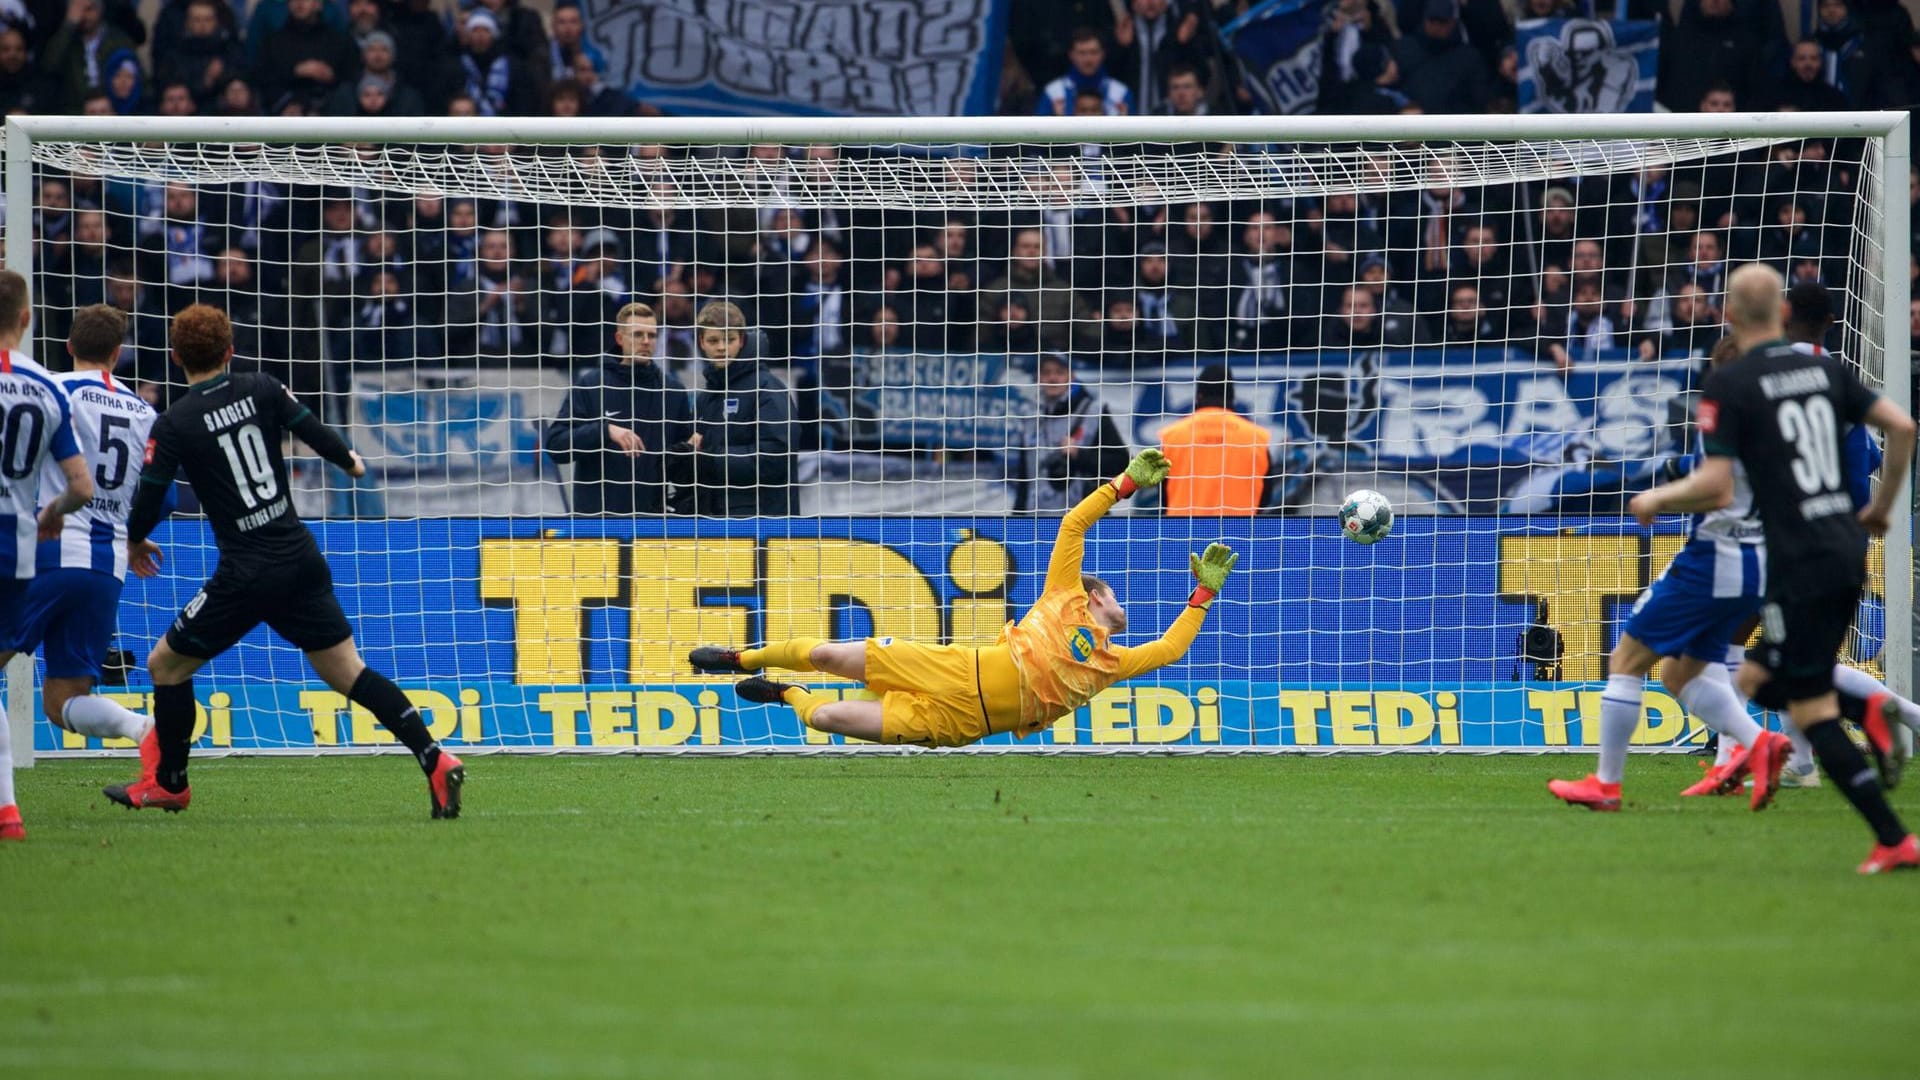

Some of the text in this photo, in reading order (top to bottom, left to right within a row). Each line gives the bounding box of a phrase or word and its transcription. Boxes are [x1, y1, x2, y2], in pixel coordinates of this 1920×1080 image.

[82, 389, 122, 409] HERTHA
[203, 396, 257, 432] SARGENT
[0, 403, 44, 480] 0
[96, 413, 130, 490] 5
[217, 424, 278, 509] 19
[1777, 395, 1841, 495] 30
[480, 537, 1010, 684] TEDi
[1067, 627, 1092, 658] TED
[539, 689, 720, 747] TEDi
[1280, 689, 1461, 746] TEDi
